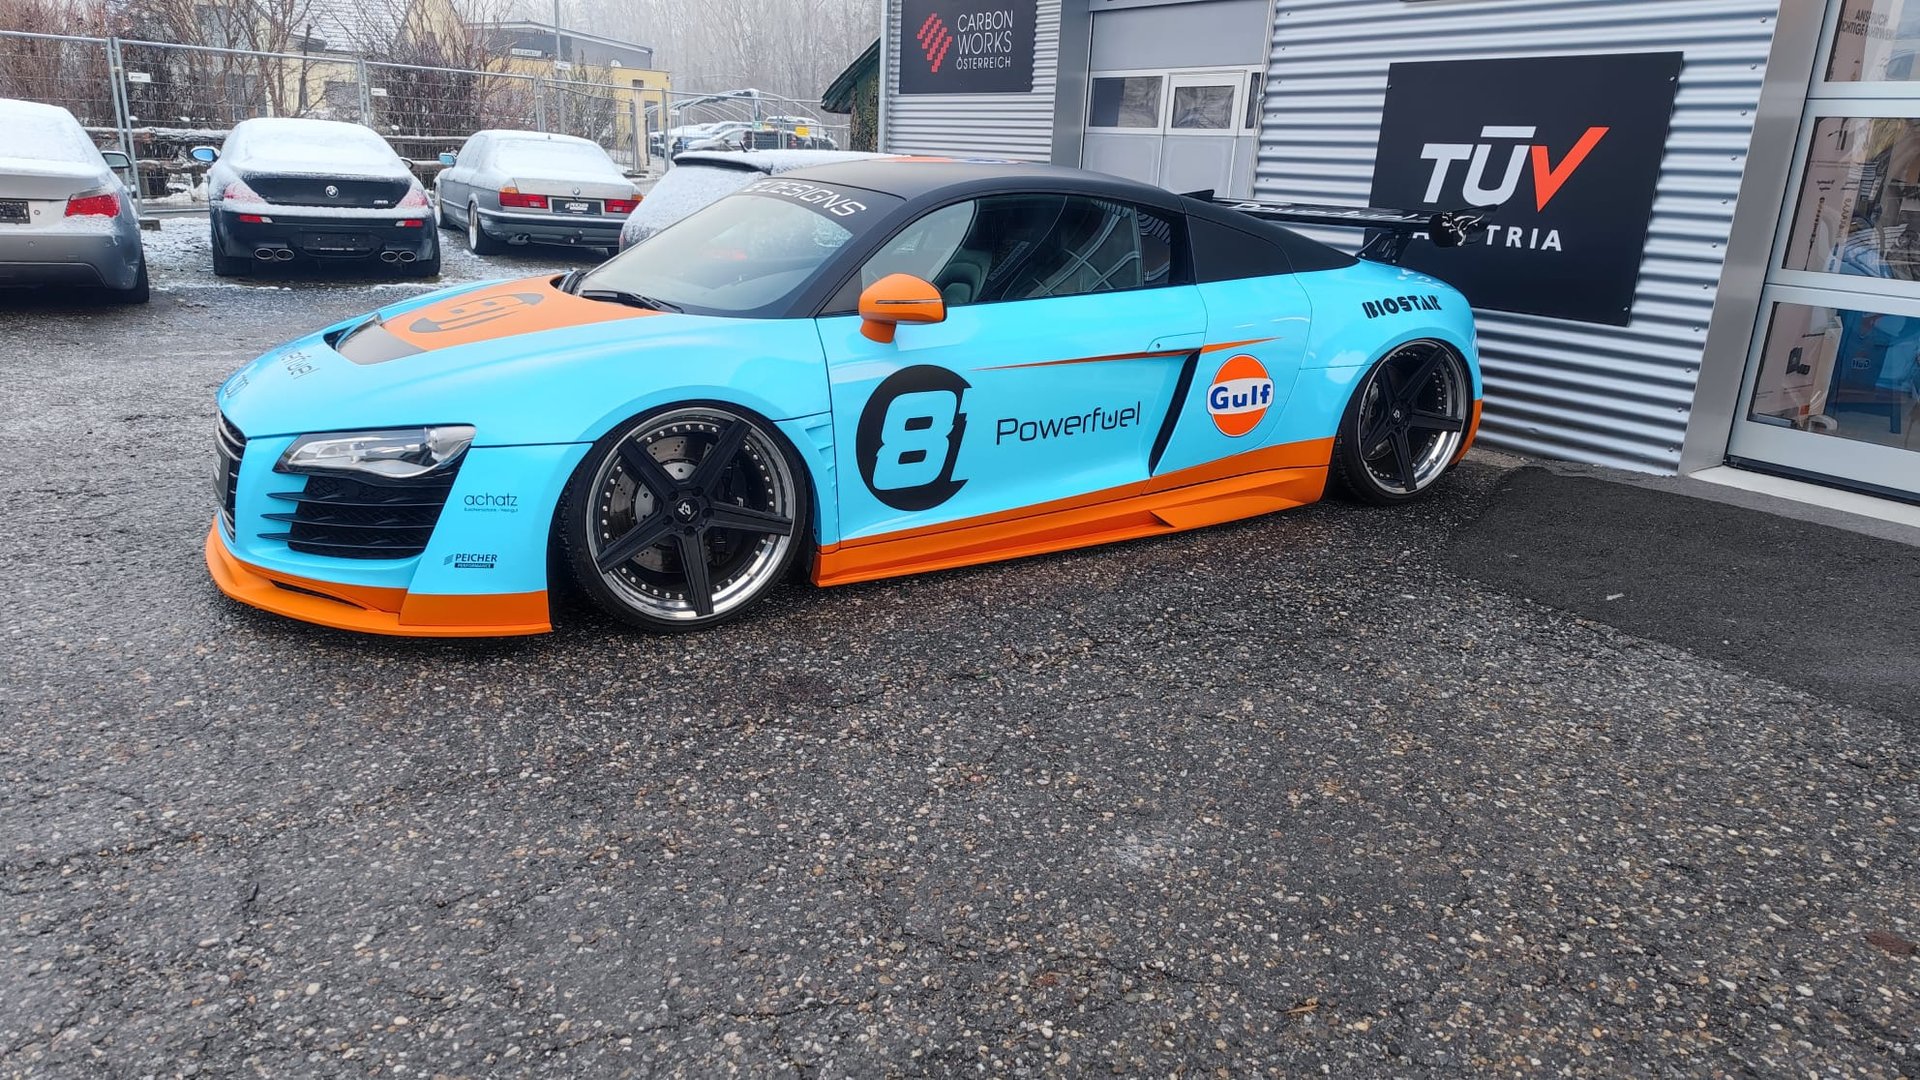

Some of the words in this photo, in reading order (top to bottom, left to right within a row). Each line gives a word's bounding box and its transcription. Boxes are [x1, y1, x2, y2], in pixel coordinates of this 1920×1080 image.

[957, 10, 1014, 32] CARBON
[957, 31, 1012, 55] WORKS
[956, 56, 1011, 70] ÖSTERREICH
[1412, 225, 1562, 252] TRIA
[1362, 295, 1442, 319] BIOSTAR
[1209, 384, 1272, 410] Gulf
[996, 401, 1141, 445] Powerfuel
[463, 492, 518, 507] achatz
[455, 553, 498, 562] PEICHER
